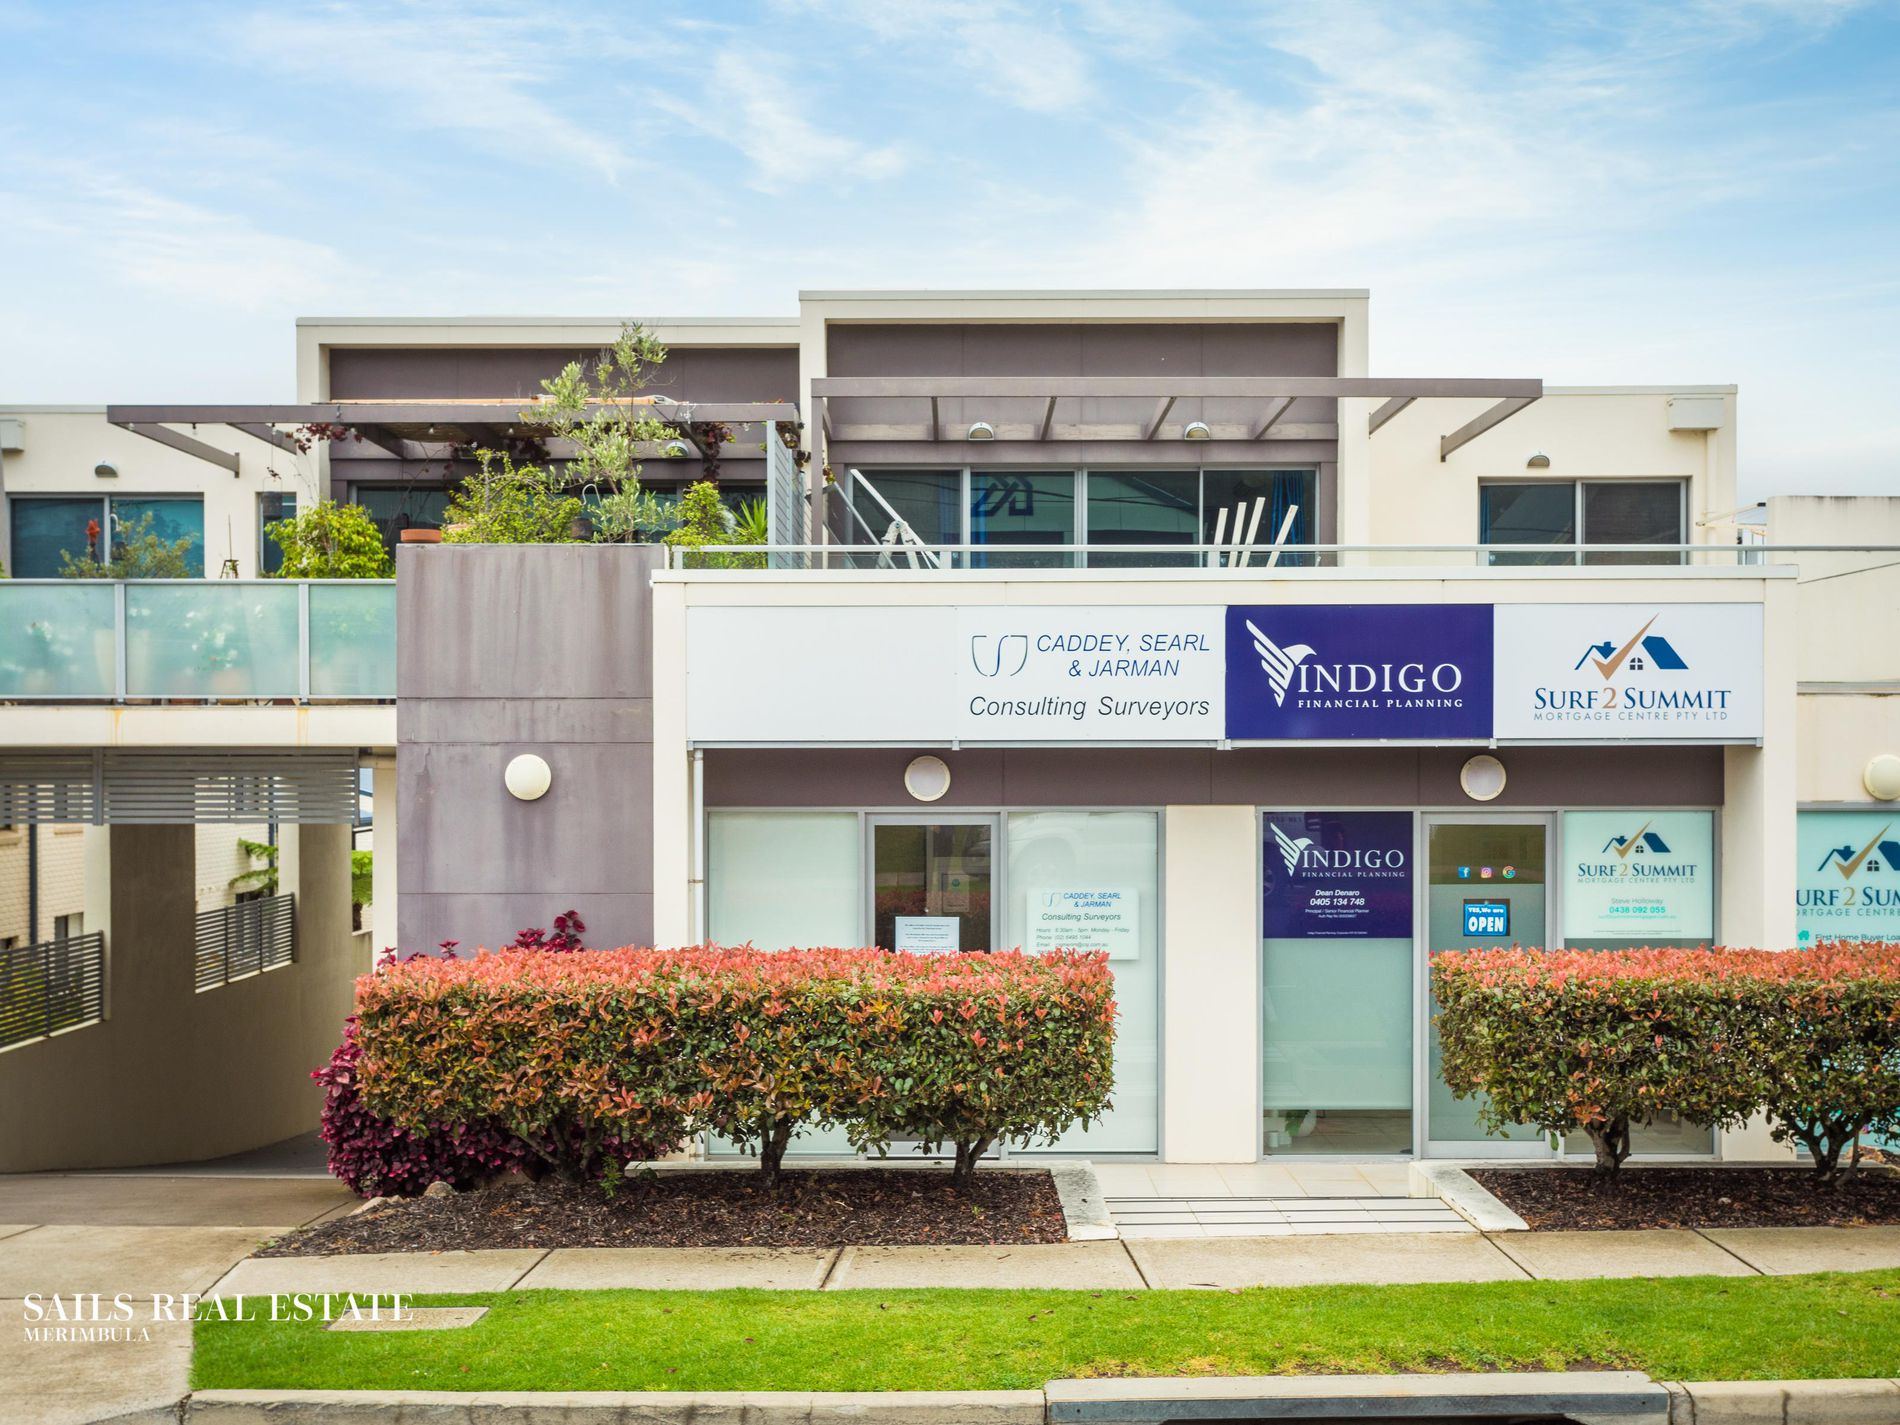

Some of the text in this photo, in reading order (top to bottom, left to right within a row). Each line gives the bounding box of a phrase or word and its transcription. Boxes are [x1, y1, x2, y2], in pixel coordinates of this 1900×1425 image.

[1036, 633, 1211, 655] CADDEY, SEARL
[1068, 659, 1180, 678] & JARMAN
[1298, 664, 1462, 692] INDIGO
[1298, 698, 1463, 708] FINANCIAL PLANNING
[1534, 687, 1731, 710] SURF 2 SUMMIT
[969, 696, 1210, 721] Consulting Surveyors
[1534, 712, 1728, 721] MORTGAGE CENTRE PTY LTD
[1302, 850, 1404, 868] INDIGO
[1578, 863, 1697, 877] SURF 2 SUMMIT
[1097, 892, 1121, 900] SEARL
[1310, 898, 1365, 906] 0405 134 748
[1632, 897, 1664, 905] Holloway
[1796, 889, 1839, 906] URF
[1843, 886, 1856, 906] 2
[1042, 912, 1121, 922] Consulting Surveyors
[1609, 906, 1666, 914] 0438 092 055
[1468, 916, 1504, 932] OPEN
